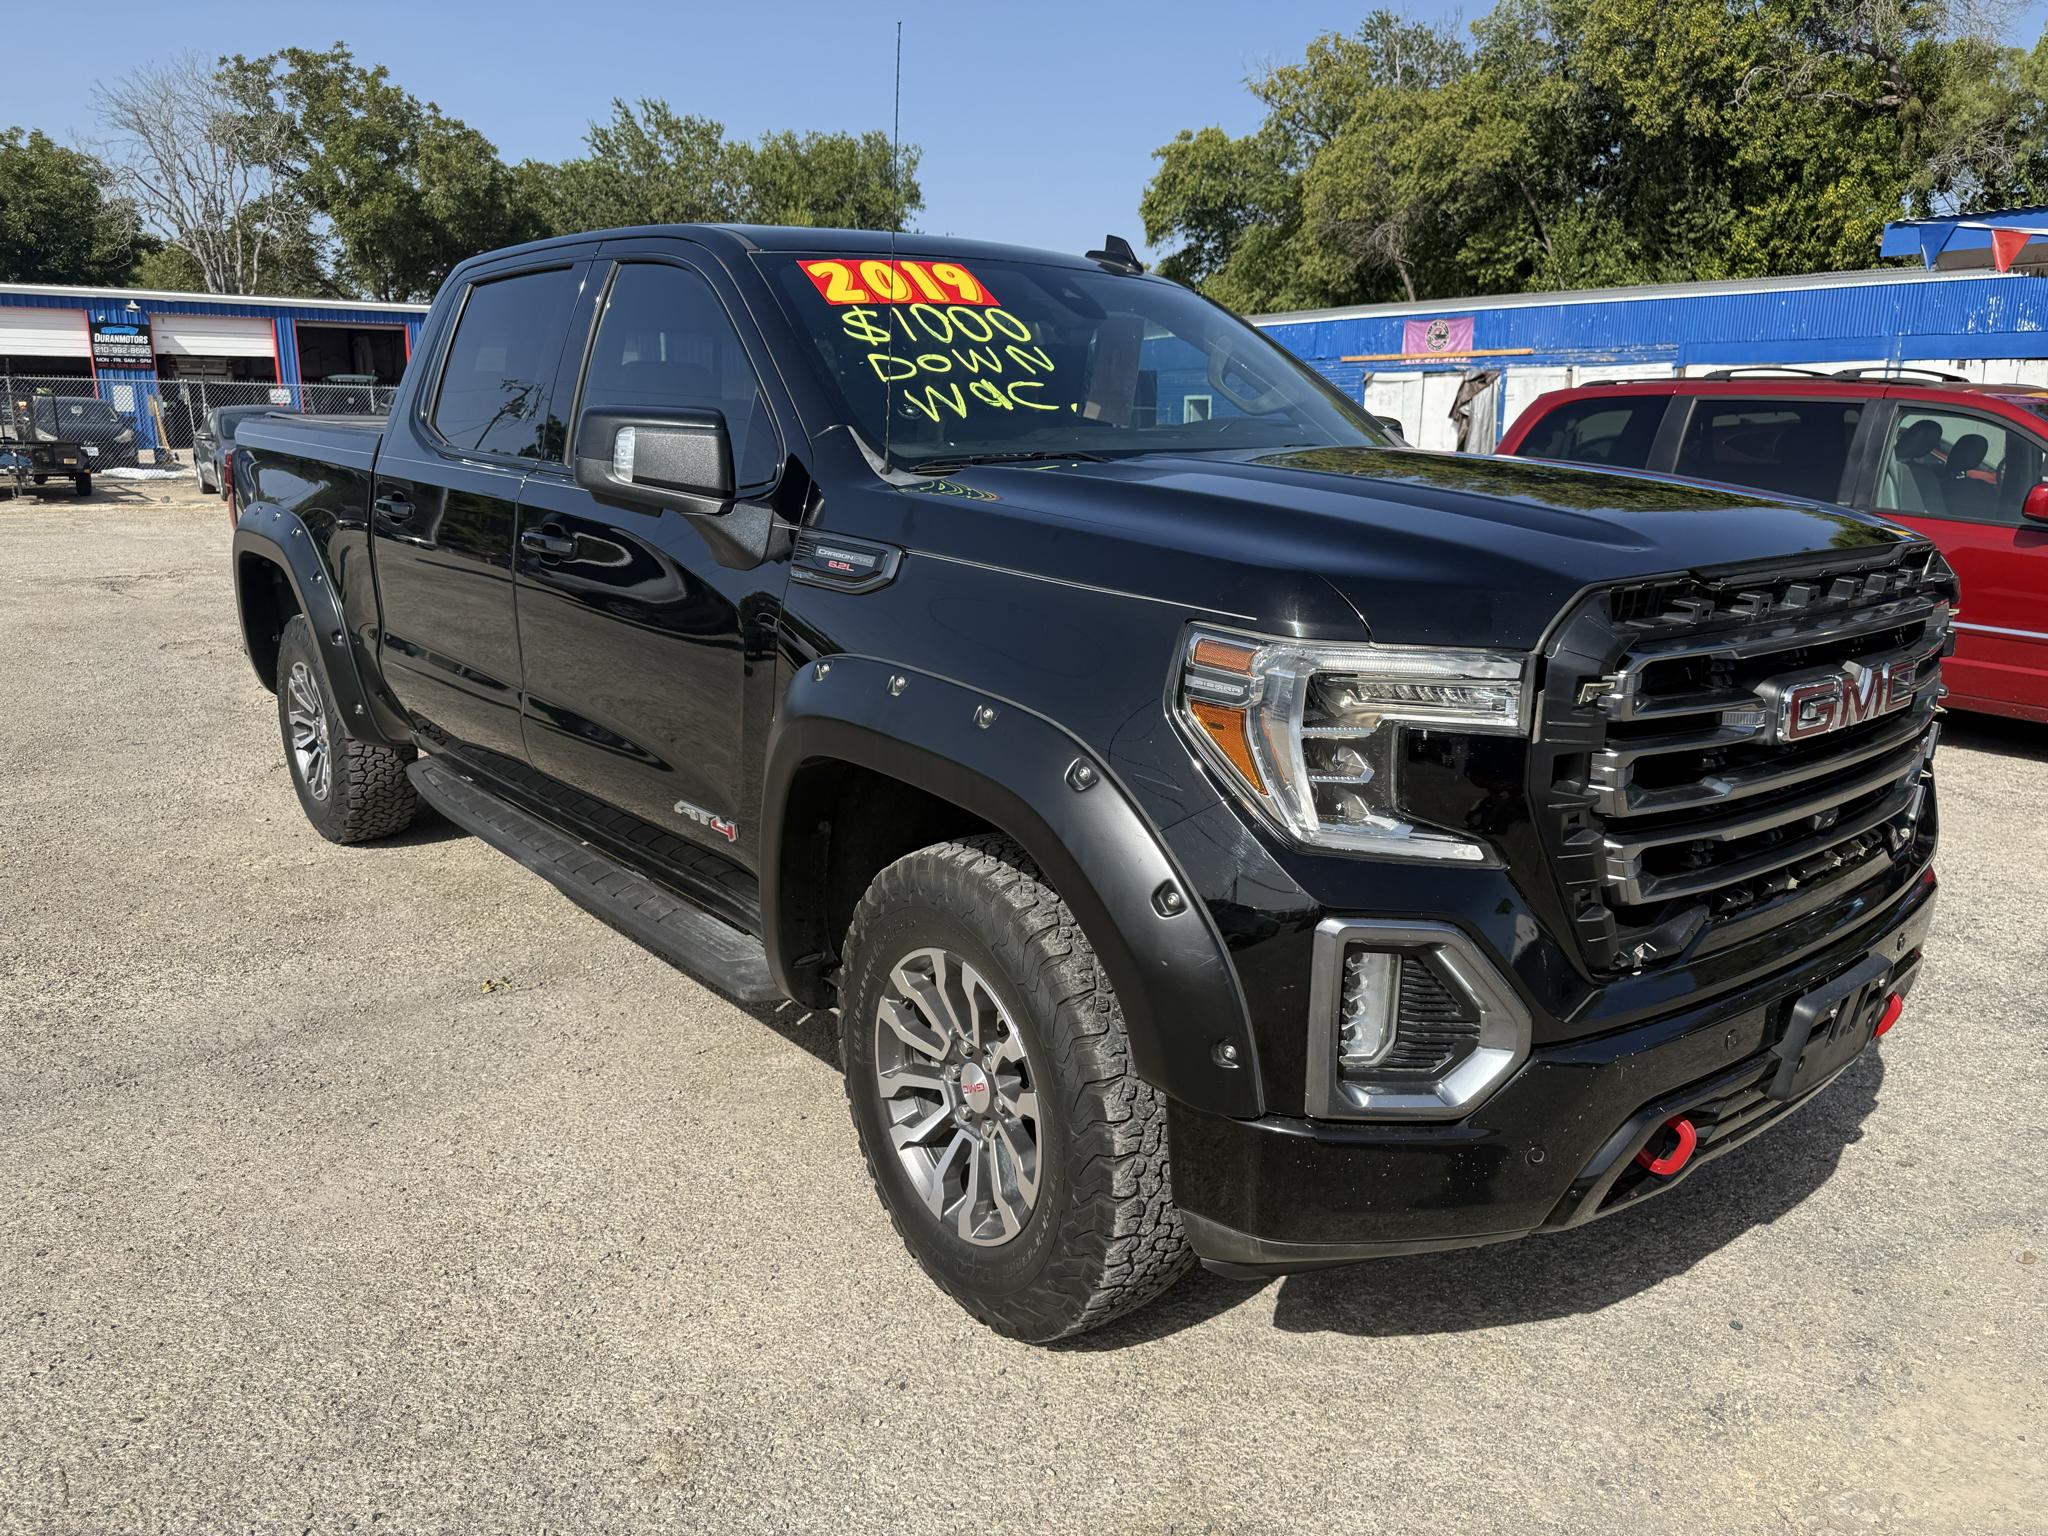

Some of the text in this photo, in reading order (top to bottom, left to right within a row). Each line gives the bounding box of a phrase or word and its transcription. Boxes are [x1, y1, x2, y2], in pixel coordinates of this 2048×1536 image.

[808, 261, 984, 304] 2019
[841, 303, 1032, 346] $1000
[1778, 661, 1916, 742] GMC
[673, 800, 737, 842] AT4
[962, 1082, 986, 1095] GMC
